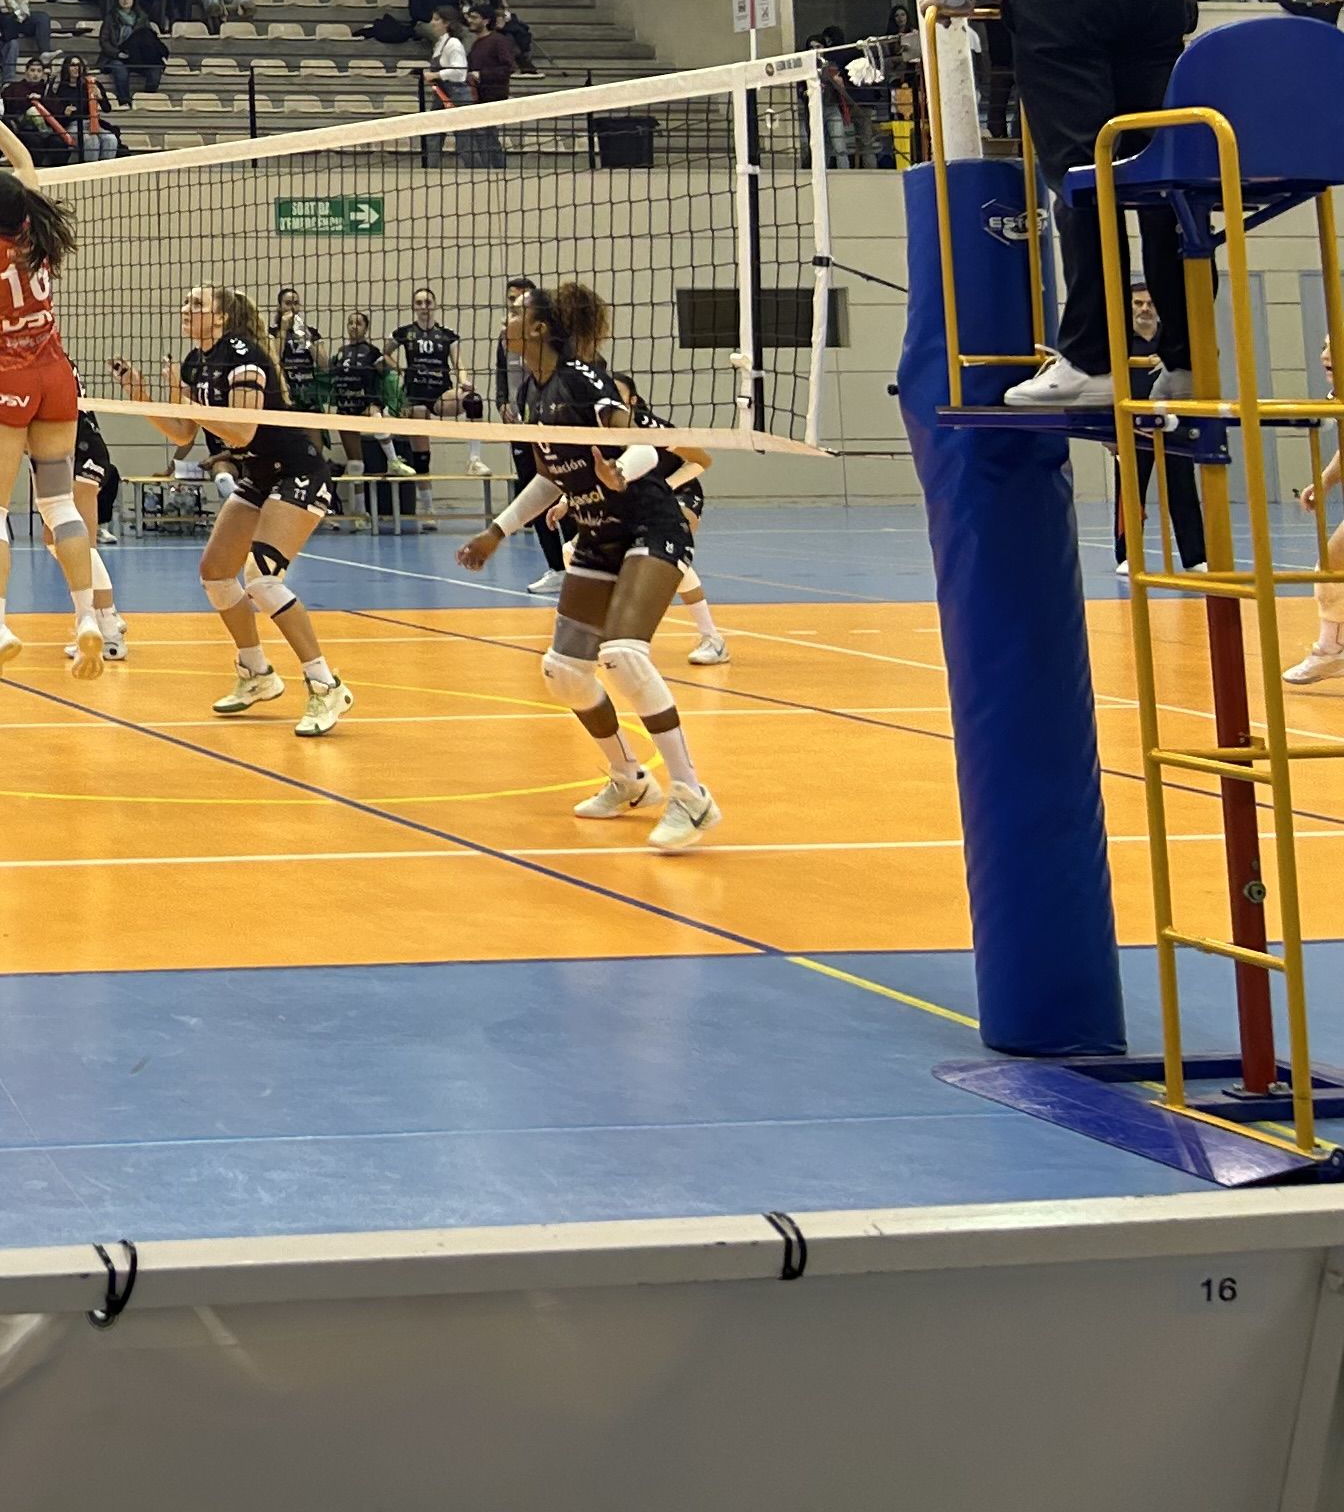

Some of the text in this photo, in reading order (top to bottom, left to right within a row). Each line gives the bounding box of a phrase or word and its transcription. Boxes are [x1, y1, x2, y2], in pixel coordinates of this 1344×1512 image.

[292, 202, 329, 215] SORTDA
[417, 339, 434, 354] 10
[1200, 1277, 1237, 1302] 16
